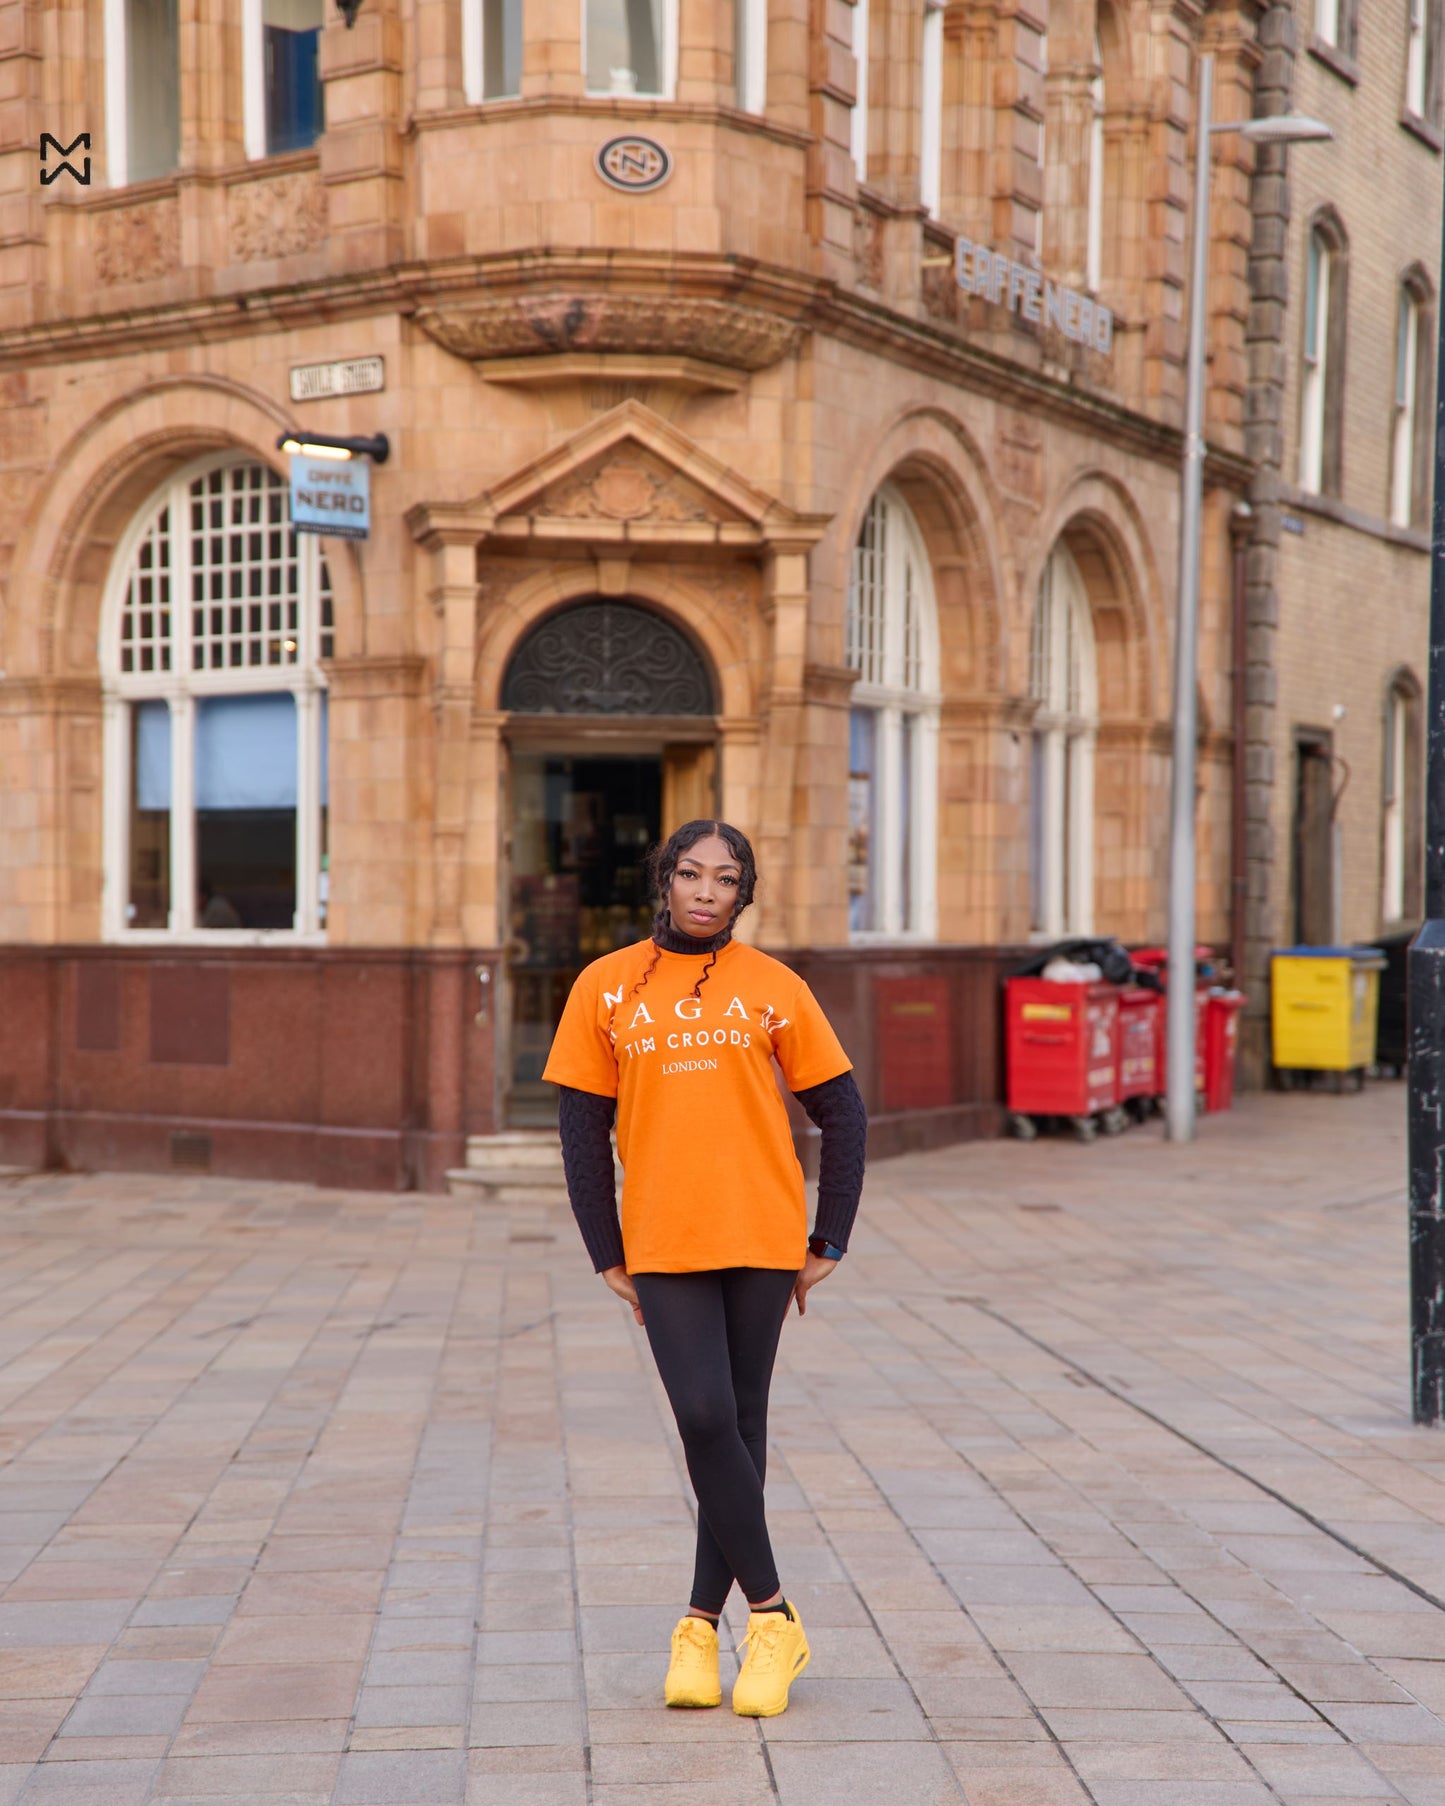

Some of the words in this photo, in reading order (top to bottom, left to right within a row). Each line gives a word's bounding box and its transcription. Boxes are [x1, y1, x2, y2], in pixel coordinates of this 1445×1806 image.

[1043, 278, 1114, 355] NERO
[296, 488, 365, 514] NERO
[666, 1028, 752, 1049] CROODS
[661, 1057, 718, 1075] LONDON
